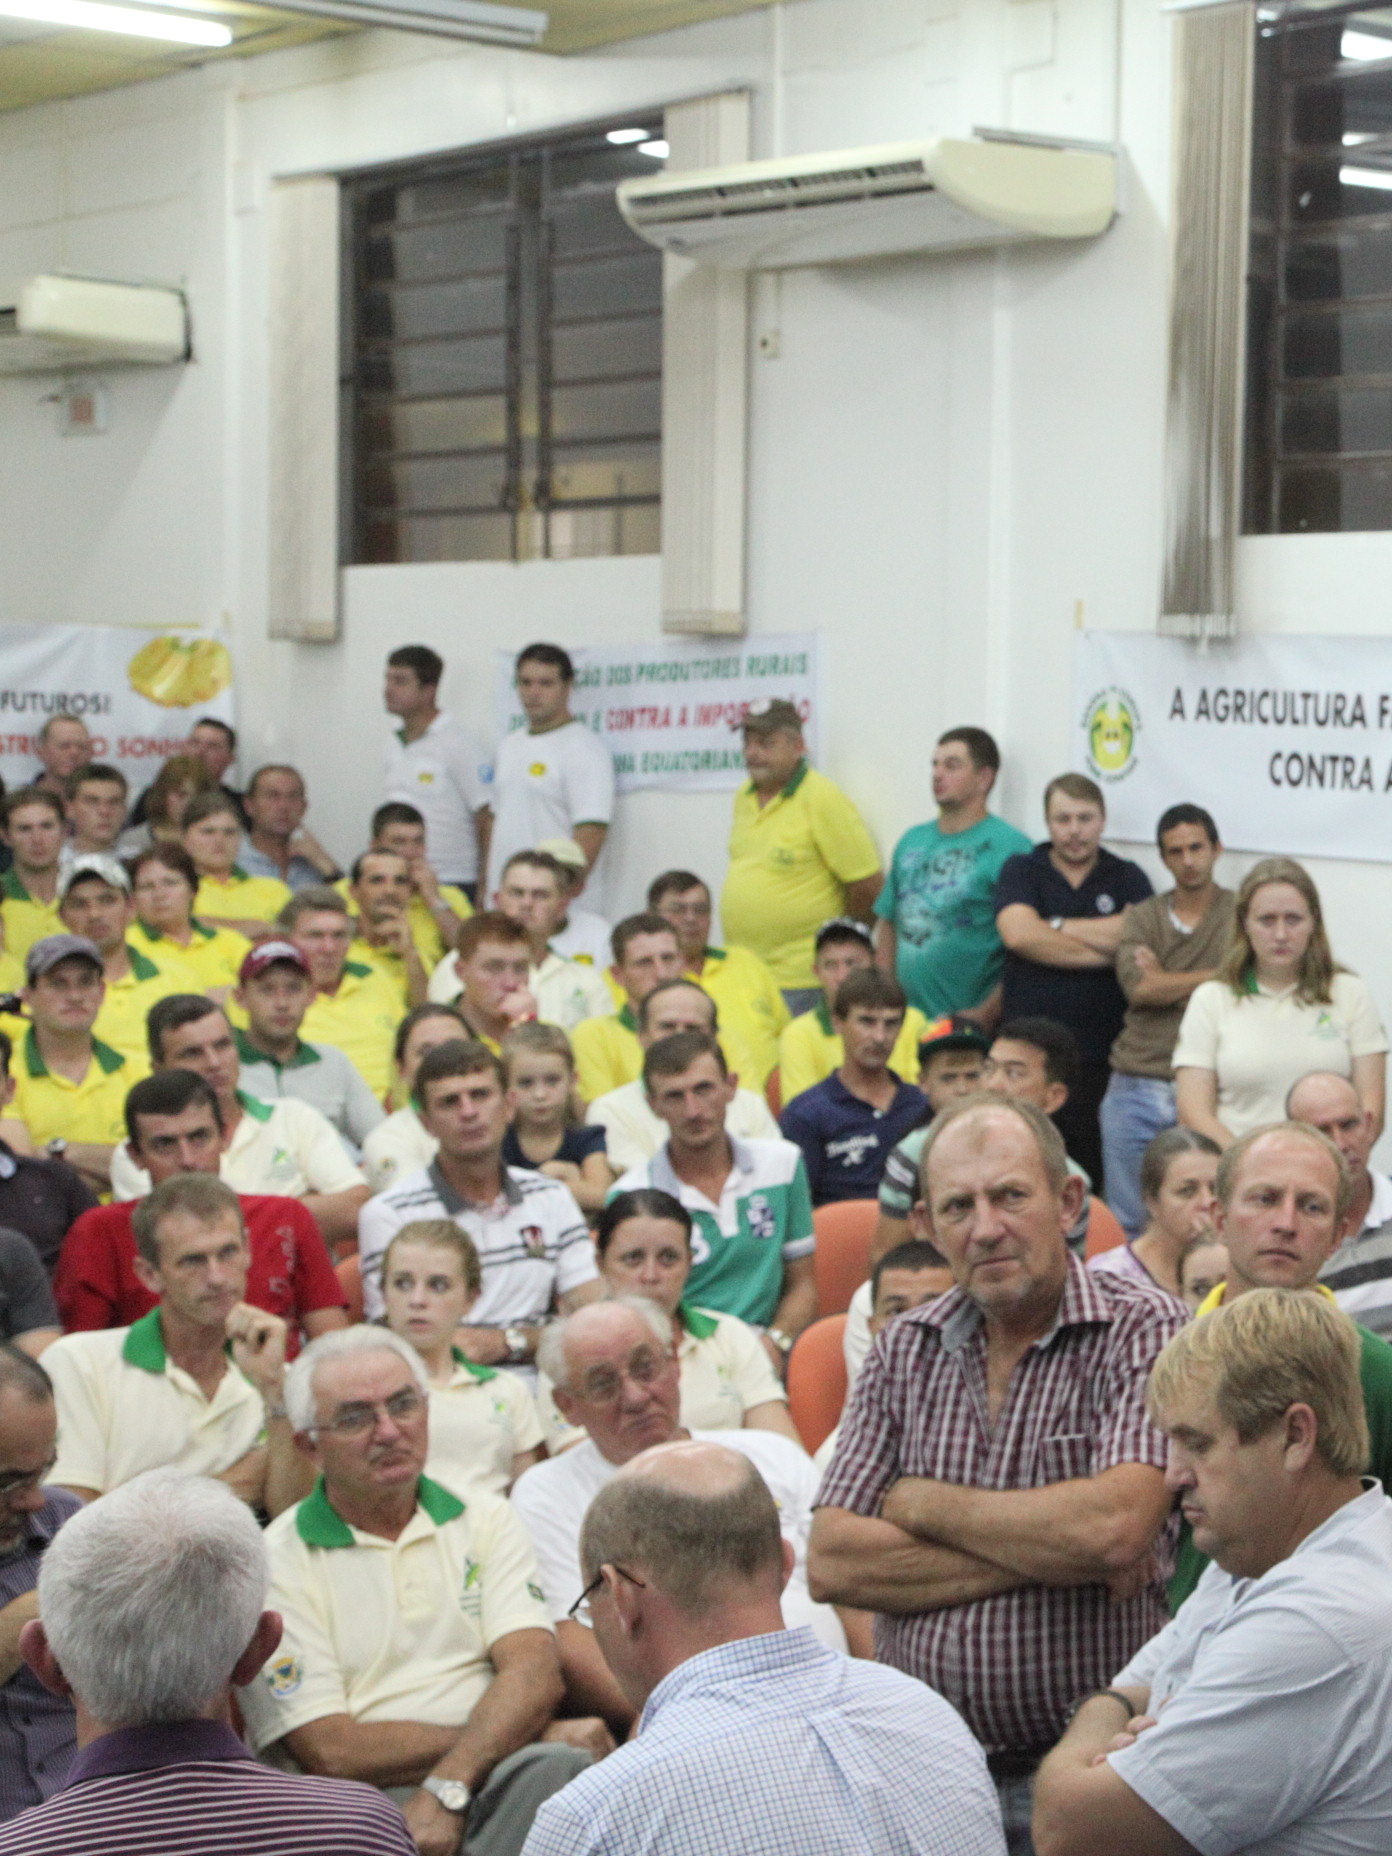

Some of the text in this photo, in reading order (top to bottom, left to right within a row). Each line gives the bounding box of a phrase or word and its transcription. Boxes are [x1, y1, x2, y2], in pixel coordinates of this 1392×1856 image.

[606, 665, 632, 686] DOS
[637, 656, 740, 685] PRODUTORES
[745, 652, 808, 677] RURAIS
[606, 706, 672, 731] CONTRA
[677, 706, 688, 726] A
[1168, 686, 1186, 721] A
[1194, 686, 1368, 730] AGRICULTURA
[1268, 750, 1374, 793] CONTRA
